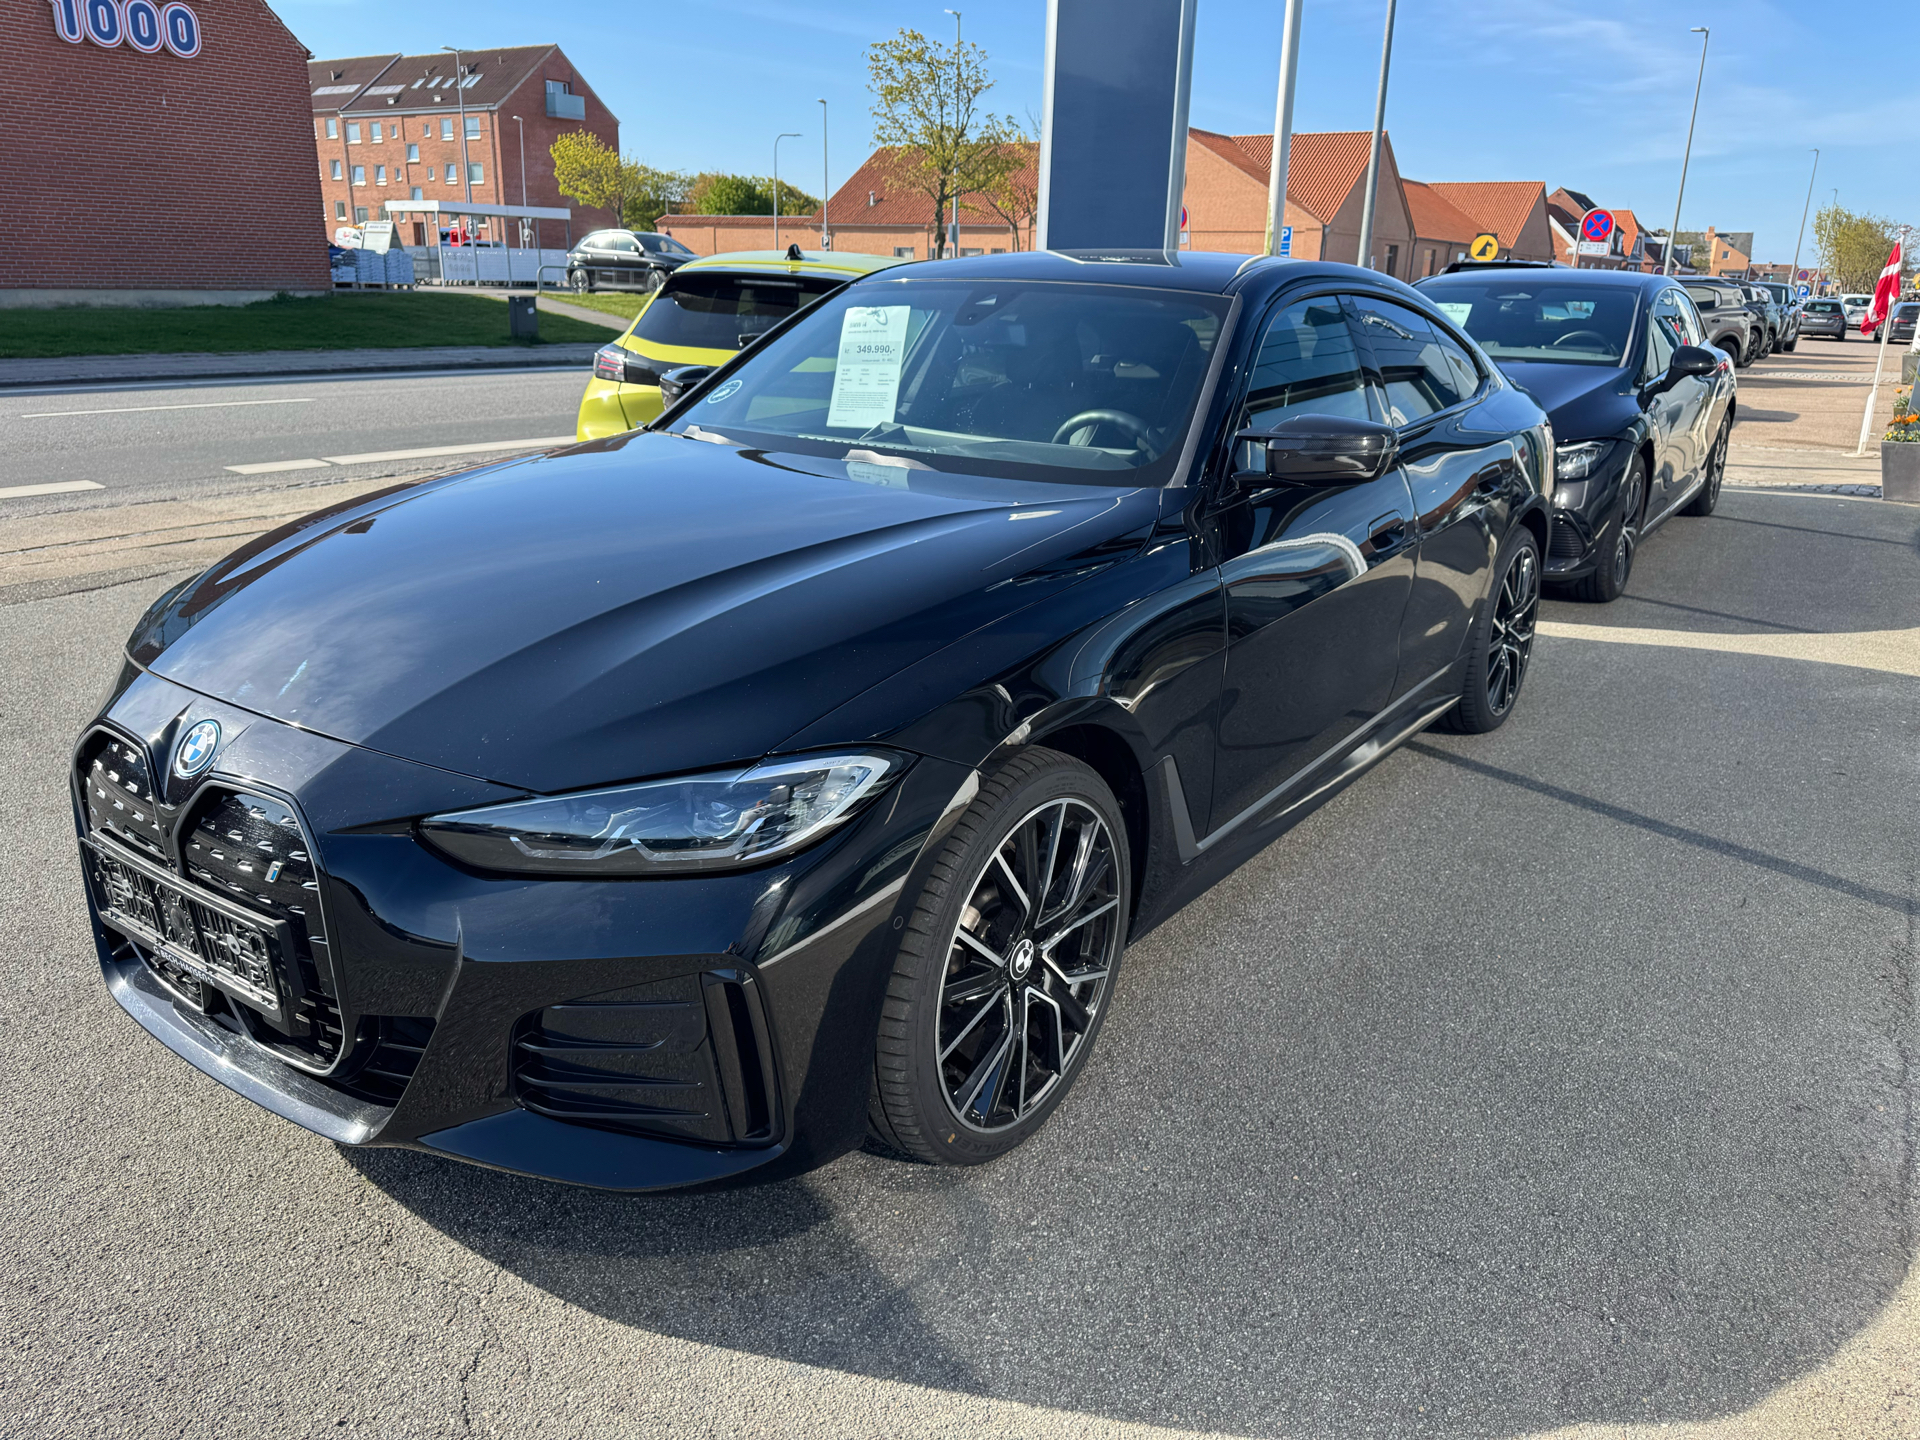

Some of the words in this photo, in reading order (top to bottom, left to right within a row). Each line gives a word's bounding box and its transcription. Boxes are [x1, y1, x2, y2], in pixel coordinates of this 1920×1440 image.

[52, 0, 201, 58] 1000
[1282, 229, 1289, 240] P
[1800, 286, 1807, 295] P
[857, 345, 895, 354] 349.990,-
[160, 950, 208, 982] BECH-HANSEN
